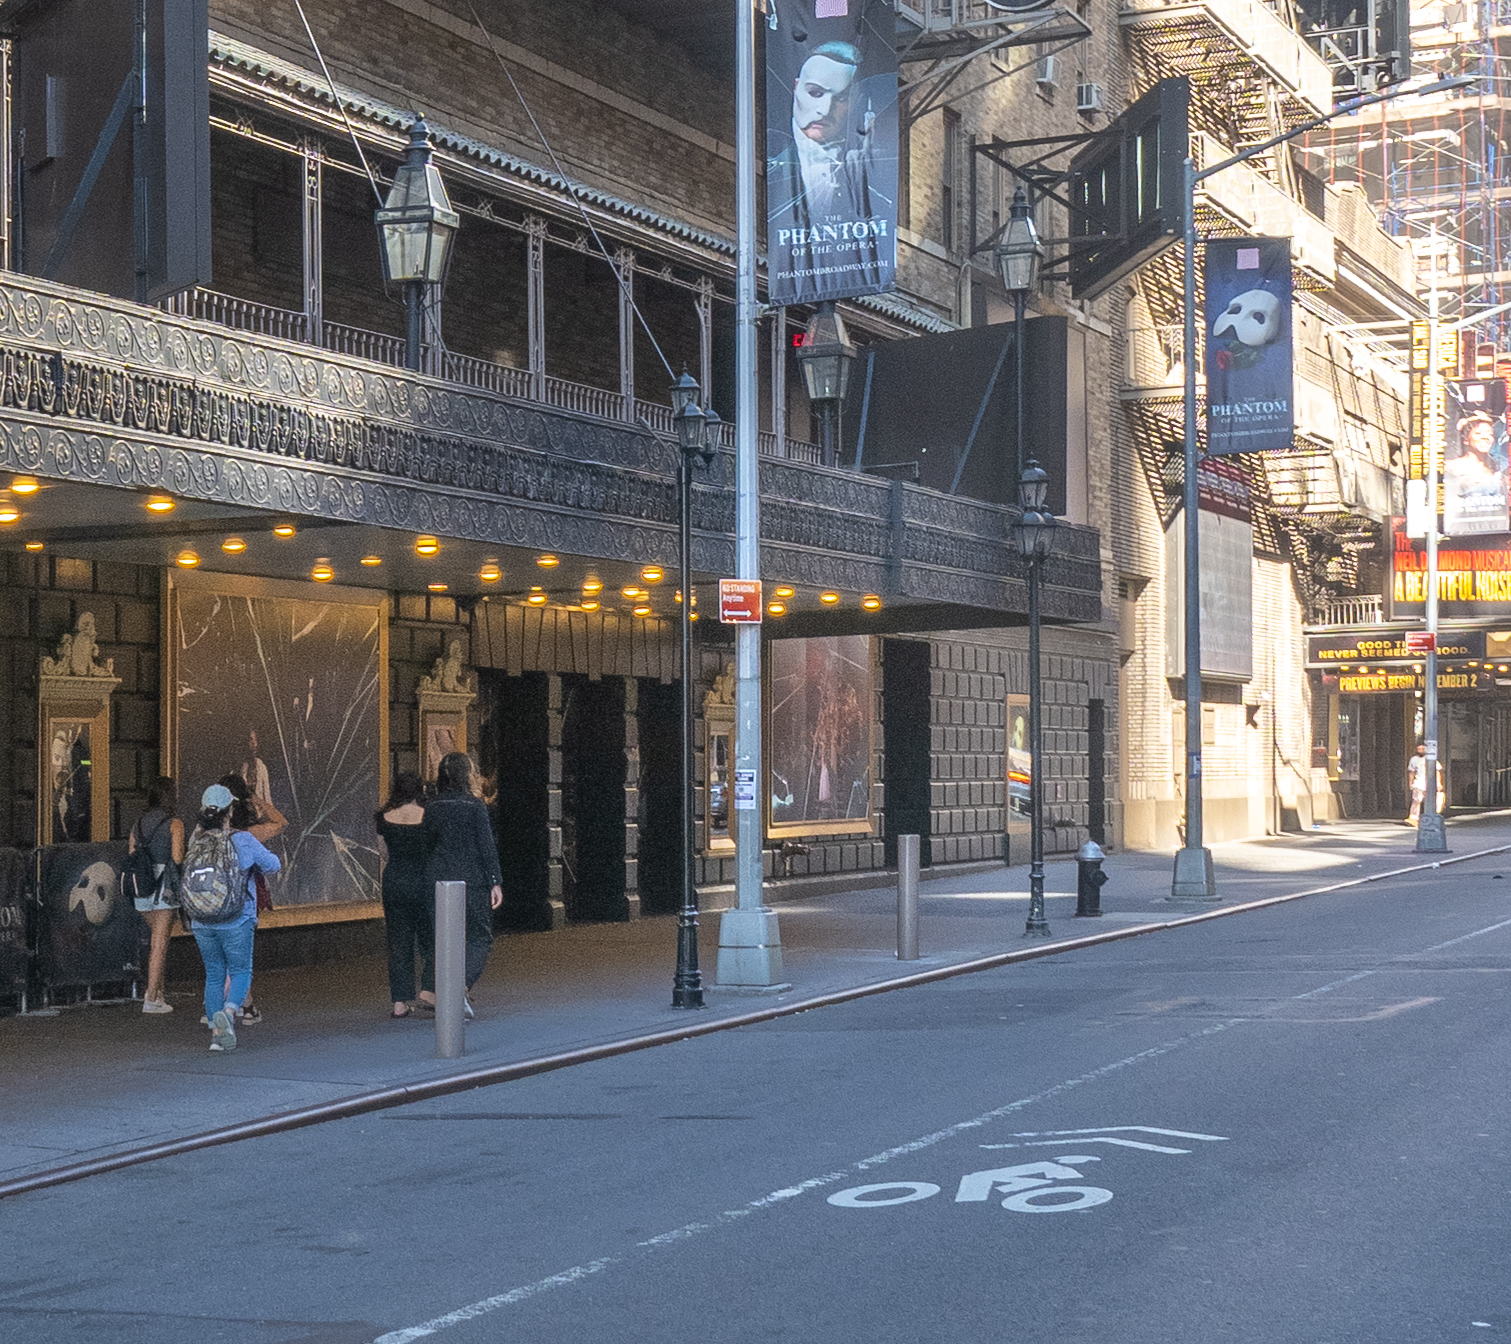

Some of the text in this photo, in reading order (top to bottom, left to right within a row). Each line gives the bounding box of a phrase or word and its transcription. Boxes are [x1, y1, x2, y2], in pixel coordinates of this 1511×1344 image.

[776, 218, 888, 246] PHANTOM
[791, 241, 875, 257] OF THE OPERA
[1211, 400, 1288, 417] PHANTOM
[1394, 549, 1511, 571] NEIL DMOND MUSICA
[1394, 570, 1405, 602] A
[1318, 649, 1358, 659] NEVER
[1360, 648, 1408, 658] SEEMED
[1356, 640, 1392, 651] GOOD
[1339, 673, 1478, 692] PREVIEWS BEGIN NEMBER 2
